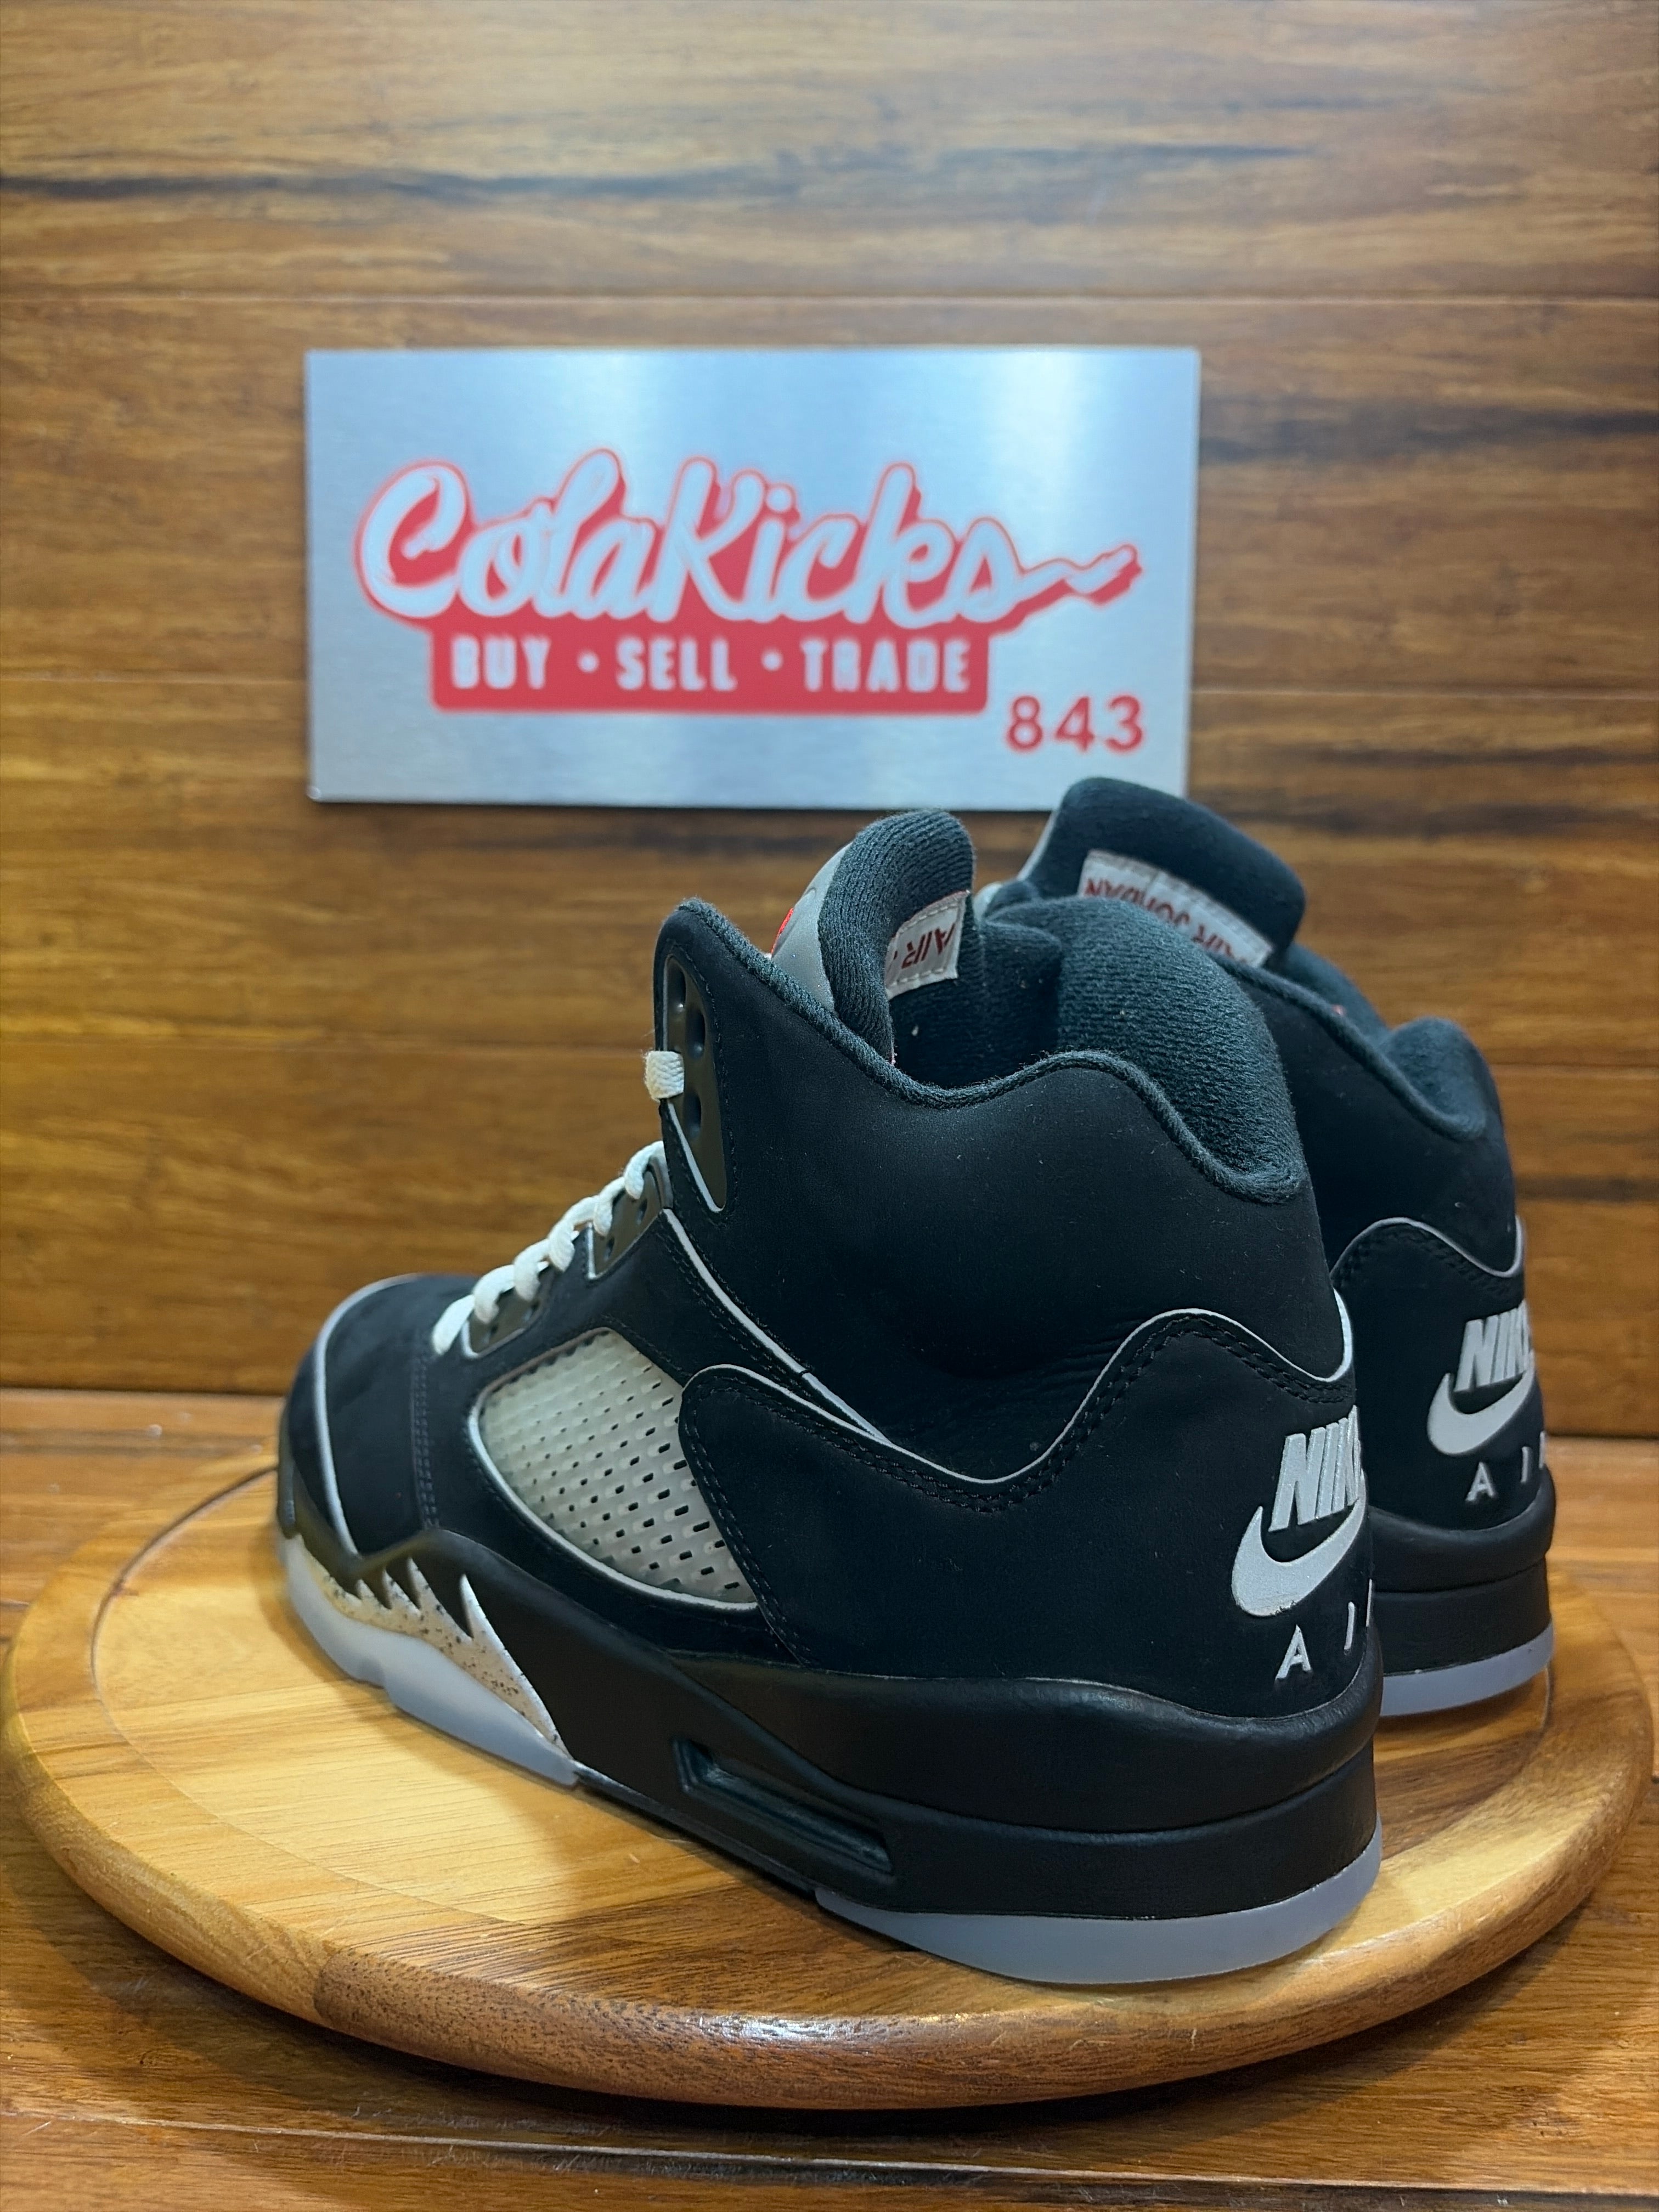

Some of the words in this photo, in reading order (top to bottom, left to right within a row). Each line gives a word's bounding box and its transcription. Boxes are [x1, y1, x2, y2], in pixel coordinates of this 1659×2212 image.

[360, 448, 1140, 628] ColaKicks
[449, 633, 551, 691] BUY
[614, 634, 738, 692] SELL
[799, 635, 972, 693] TRADE
[1005, 695, 1145, 754] 843
[901, 923, 956, 969] AIR
[1453, 1298, 1532, 1393] NIK
[1267, 1404, 1362, 1532] NIK
[1465, 1430, 1546, 1502] AI
[1274, 1578, 1373, 1680] AI
